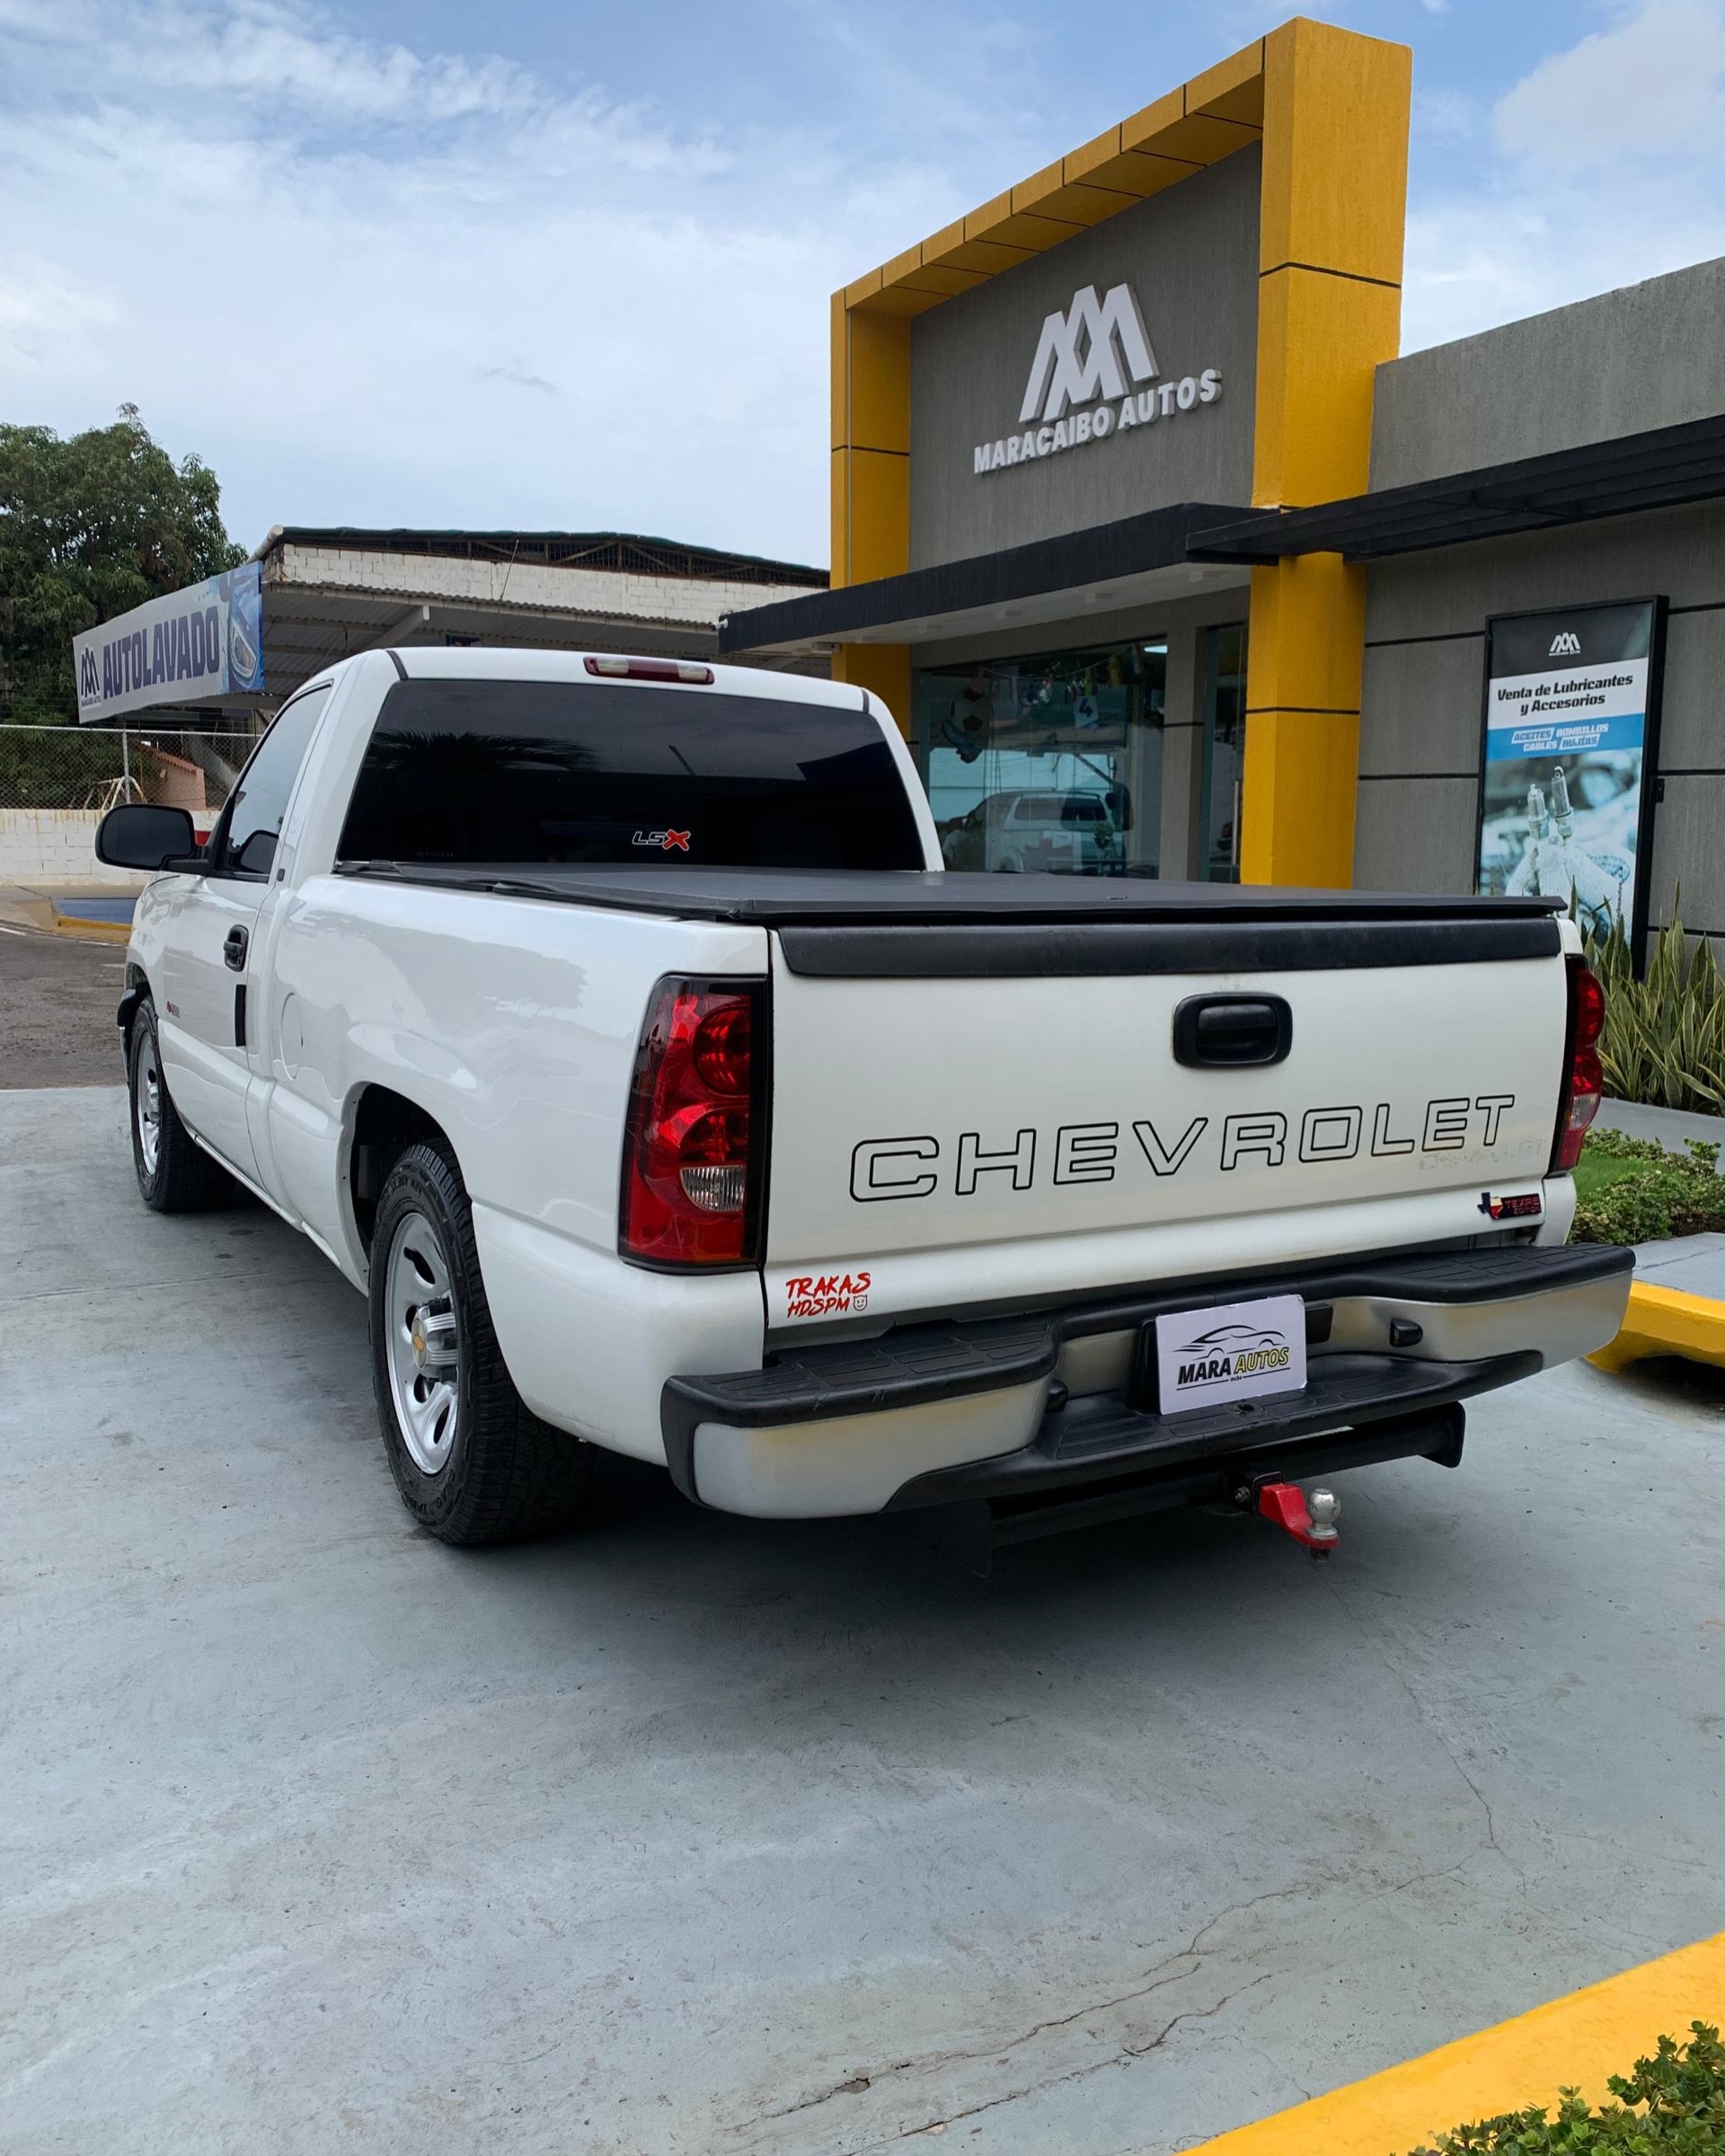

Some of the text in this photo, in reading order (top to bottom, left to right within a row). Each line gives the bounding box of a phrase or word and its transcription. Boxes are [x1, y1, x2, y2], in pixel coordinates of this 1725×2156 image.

[974, 368, 1223, 474] MARACAIBO AUTOS
[103, 605, 220, 700] AUTOLAVADO
[1498, 675, 1633, 701] Venta de Lubricantes
[1520, 694, 1606, 716] y Accesorios
[1514, 723, 1608, 741] ACEITES BOMBILLOS
[1523, 740, 1557, 752] CABLES
[632, 828, 691, 852] LSX
[850, 1094, 1515, 1203] CHEVROLET
[785, 1272, 871, 1299] TRAKAS
[787, 1296, 850, 1318] HDSPM
[1178, 1347, 1290, 1384] MARA AUTOS
